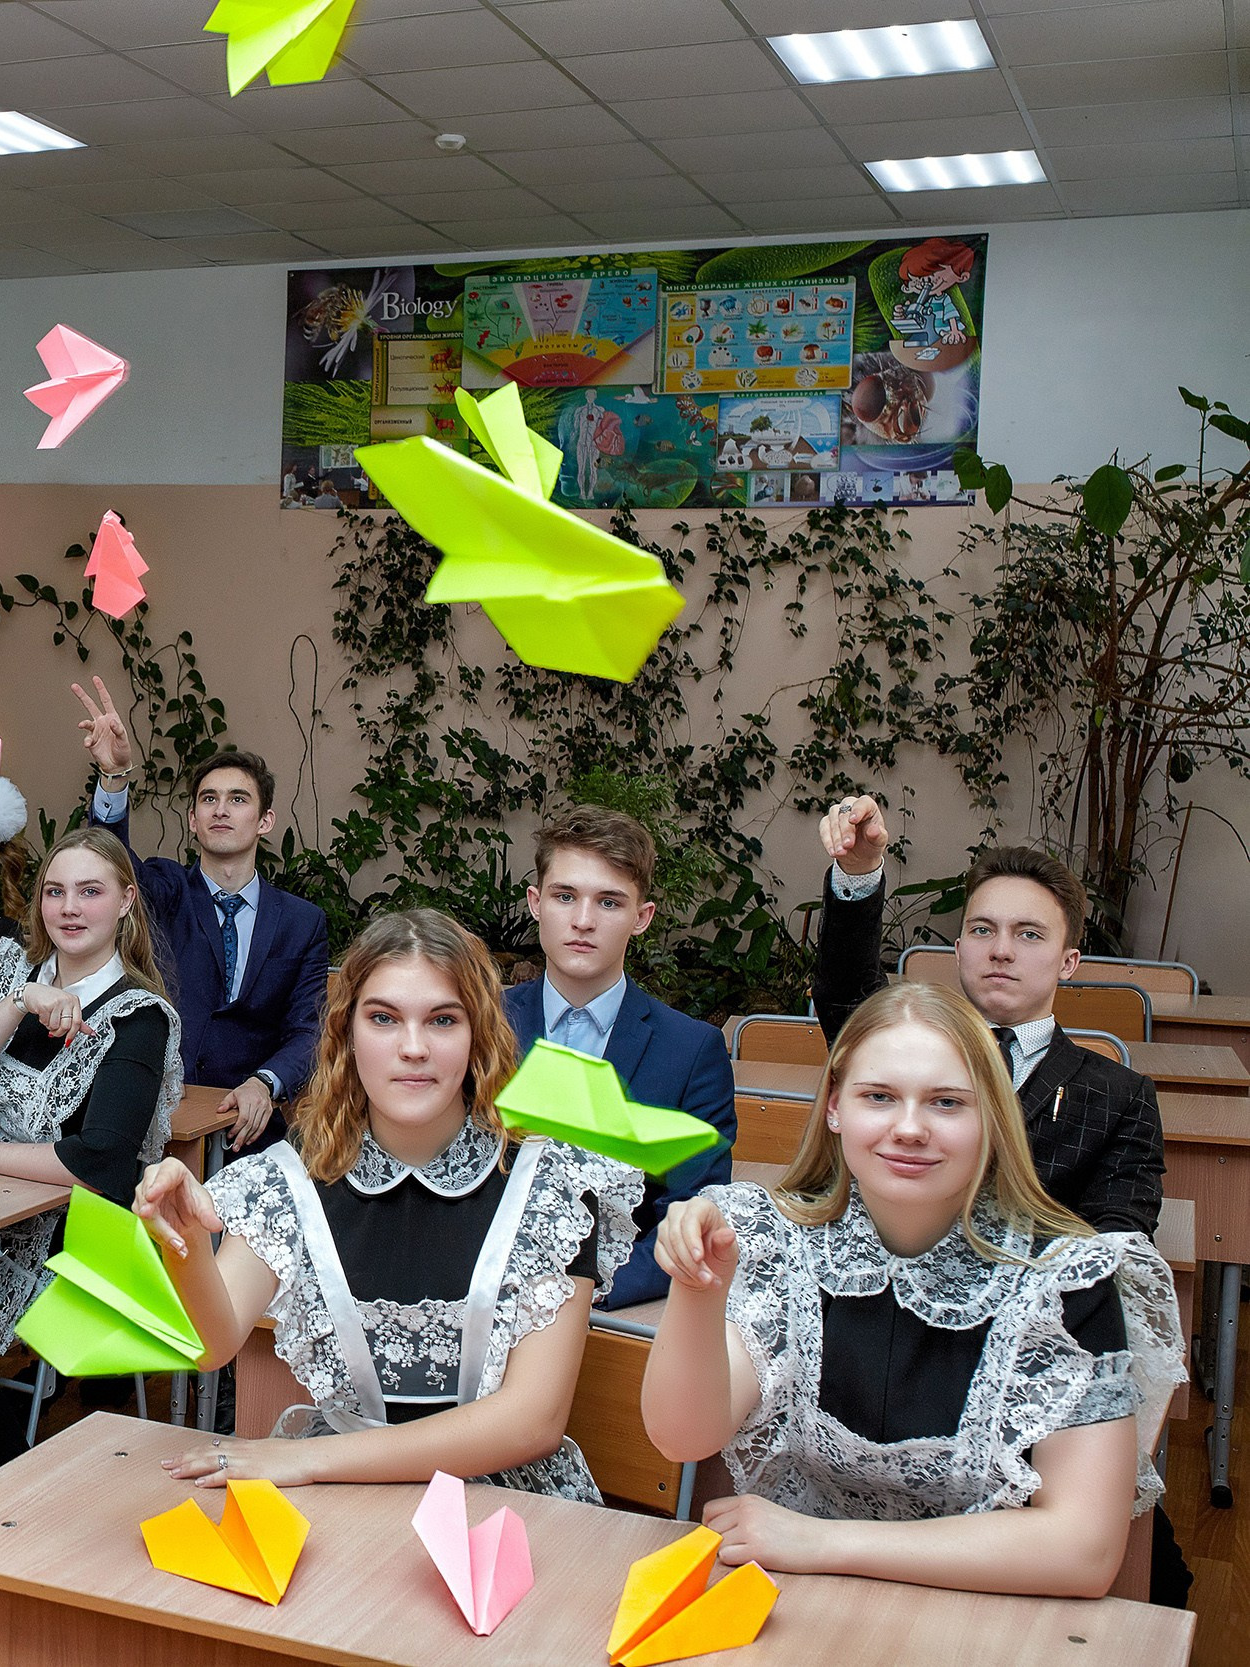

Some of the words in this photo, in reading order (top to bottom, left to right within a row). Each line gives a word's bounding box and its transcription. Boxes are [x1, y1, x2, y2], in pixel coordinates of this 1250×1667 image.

[491, 272, 585, 283] ЭВОЛЮЦИОННОЕ
[591, 269, 629, 278] ДРЕВО
[665, 283, 740, 292] МНОГООБРАЗИЕ
[743, 281, 778, 289] ЖИВЫХ
[781, 278, 846, 287] ОРГАНИЗМОВ
[380, 292, 458, 321] Biology
